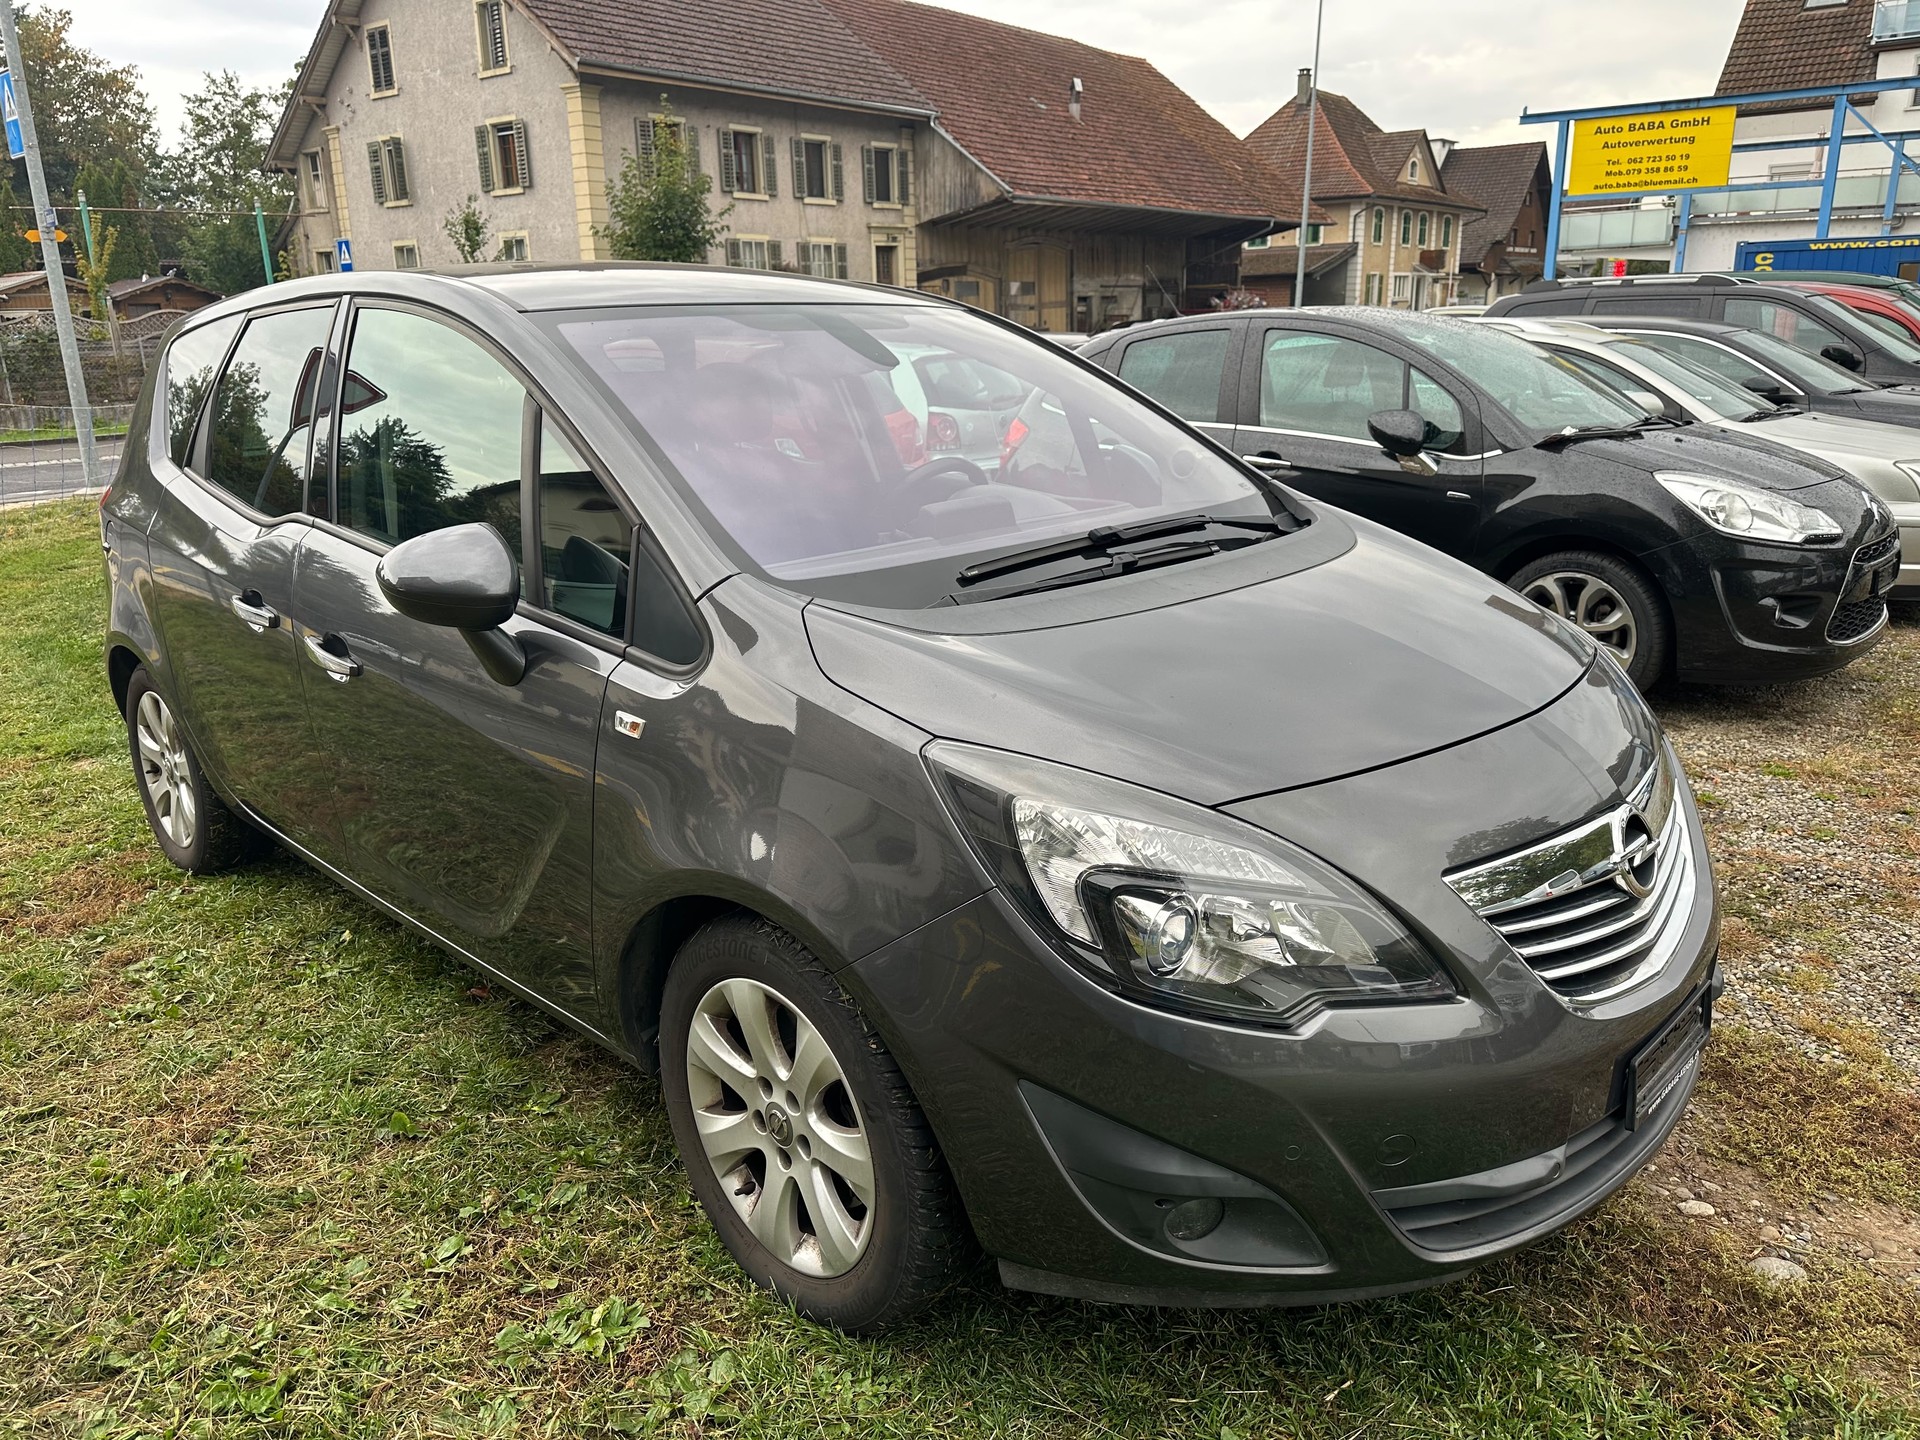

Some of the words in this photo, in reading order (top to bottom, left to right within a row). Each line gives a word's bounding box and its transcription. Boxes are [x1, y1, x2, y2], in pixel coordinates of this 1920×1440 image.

[1594, 125, 1624, 135] Auto
[1628, 120, 1665, 132] BABA
[1670, 116, 1710, 129] GmbH
[1602, 136, 1696, 149] Autoverwertung
[1627, 156, 1643, 164] 062
[1646, 155, 1662, 163] 723
[1665, 154, 1676, 162] 50
[1644, 166, 1660, 174] 358
[1677, 164, 1688, 172] 59
[1593, 177, 1698, 190] auto.baba@bluemail.ch
[673, 936, 760, 983] BRIDGESTONE
